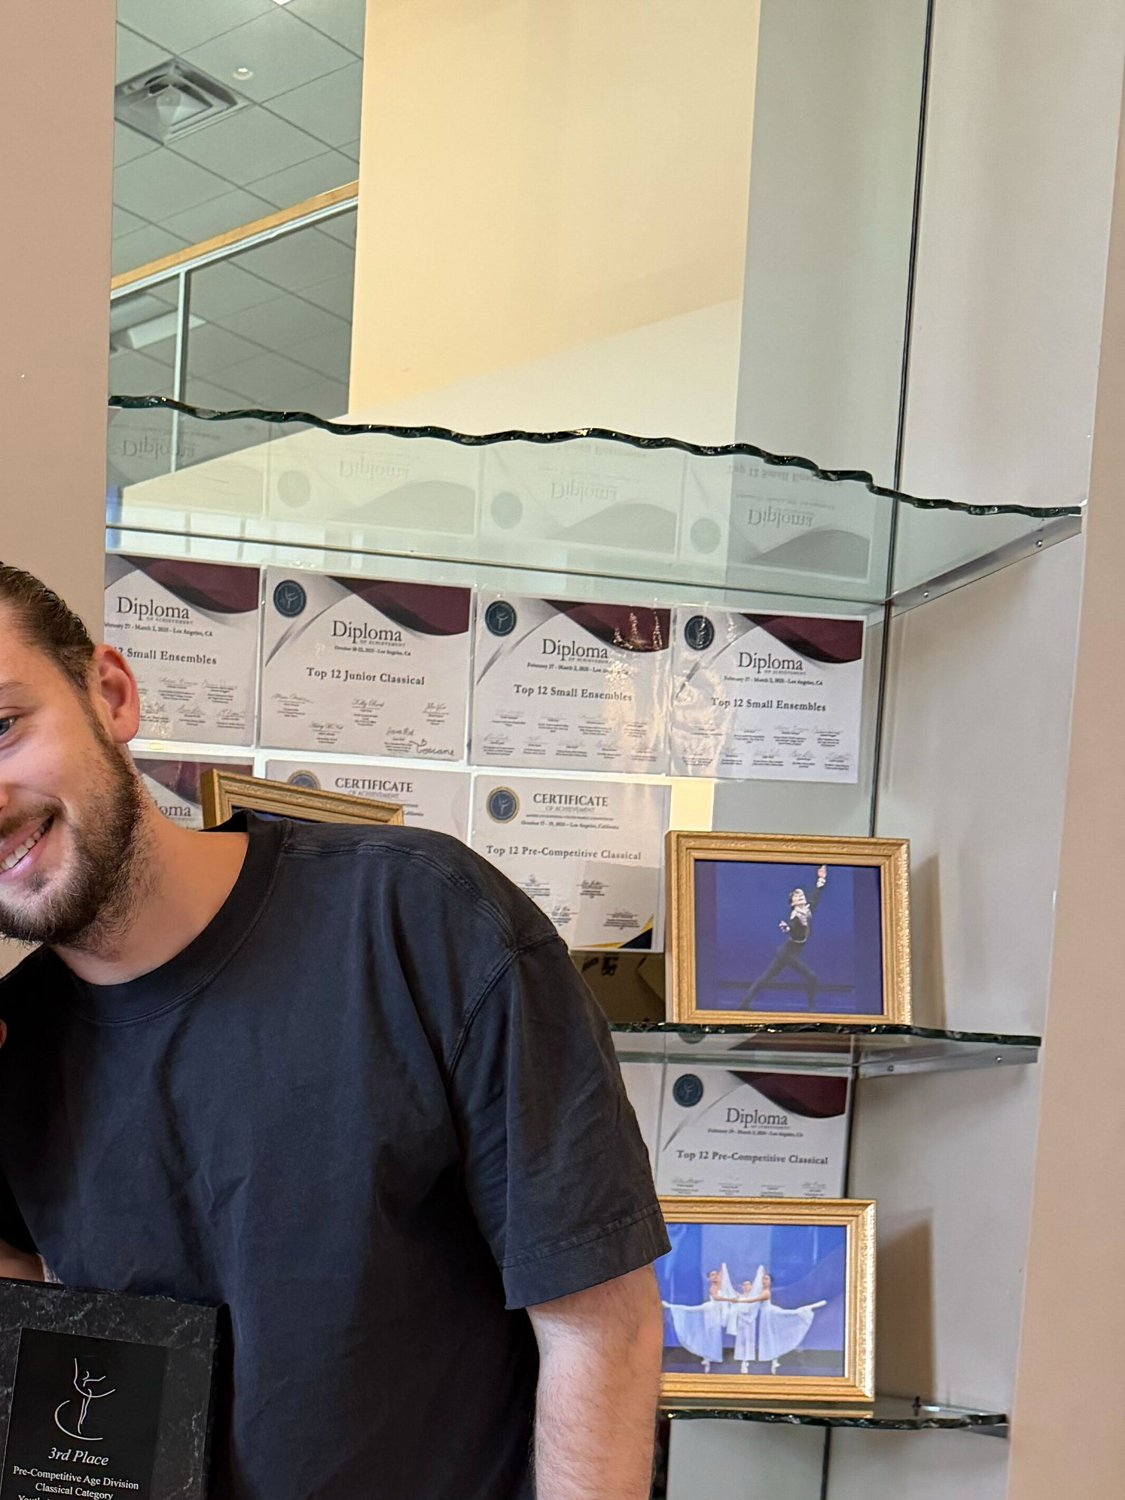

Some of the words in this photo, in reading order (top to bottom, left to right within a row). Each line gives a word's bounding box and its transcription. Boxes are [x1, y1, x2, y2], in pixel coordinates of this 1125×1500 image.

[117, 596, 189, 621] Diploma
[333, 620, 402, 643] Diploma
[127, 648, 156, 659] Small
[160, 651, 216, 665] Ensembles
[542, 639, 608, 661] Diploma
[739, 652, 802, 673] Diploma
[307, 667, 327, 680] Top
[331, 669, 341, 678] 12
[344, 670, 376, 682] Junior
[380, 674, 424, 685] Classical
[514, 684, 534, 697] Top
[538, 686, 547, 695] 12
[551, 688, 577, 697] Small
[581, 689, 632, 701] Ensembles
[711, 698, 730, 709] Top
[734, 699, 743, 707] 12
[747, 700, 772, 708] Small
[776, 701, 826, 712] Ensembles
[335, 777, 413, 792] CERTIFICATE
[533, 793, 608, 807] CERTIFICATE
[487, 846, 505, 857] Top
[509, 846, 518, 854] 12
[522, 847, 598, 859] Pre-Competitive
[601, 851, 641, 860] Classical
[726, 1108, 788, 1128] Diploma
[677, 1150, 695, 1161] Top
[699, 1151, 708, 1159] 12
[712, 1152, 785, 1163] Pre-Competitive
[789, 1155, 828, 1164] Classical
[48, 1447, 72, 1460] 3rd
[73, 1450, 109, 1465] Place
[13, 1466, 82, 1482] Pre-Competitive
[83, 1475, 101, 1486] Age
[103, 1477, 139, 1490] Division
[35, 1483, 73, 1495] Classical
[75, 1488, 113, 1500] Category
